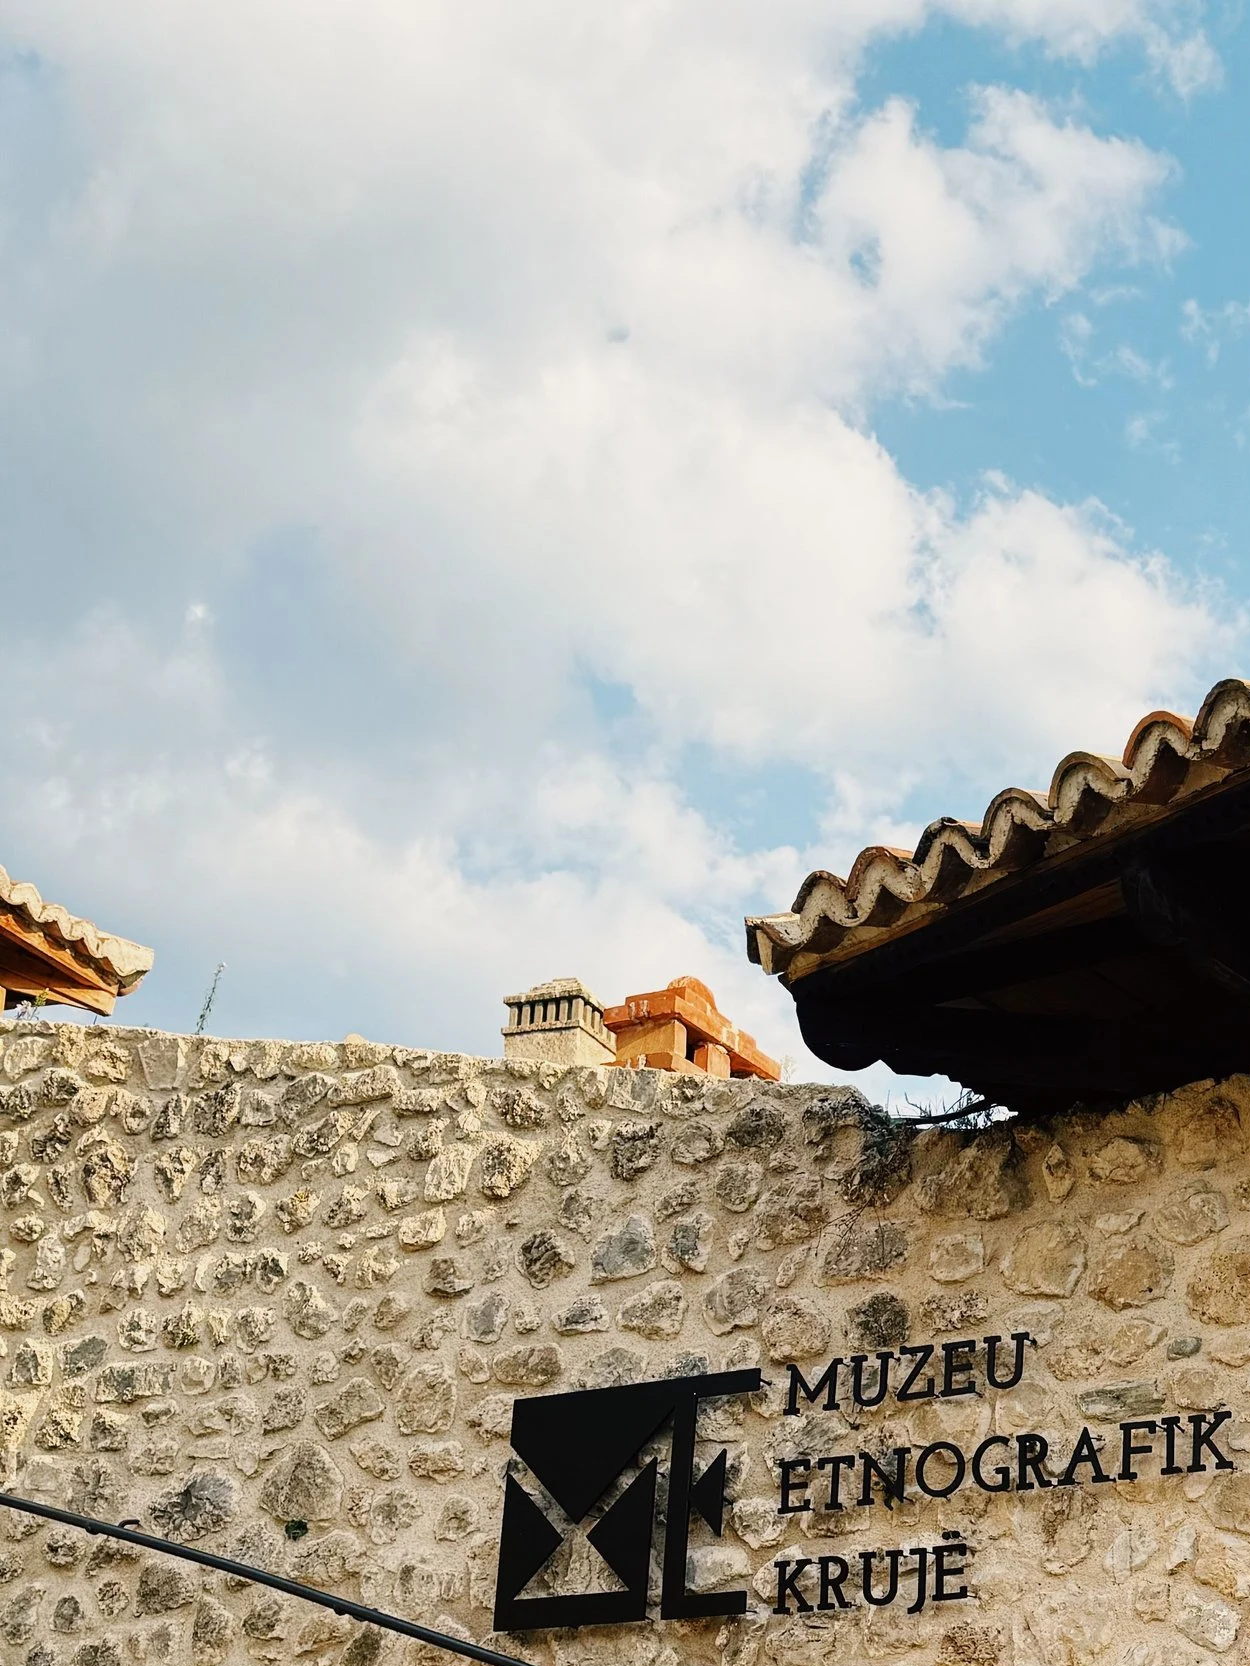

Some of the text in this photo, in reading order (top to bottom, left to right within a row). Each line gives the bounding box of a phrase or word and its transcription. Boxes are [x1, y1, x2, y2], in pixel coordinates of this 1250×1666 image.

[785, 1332, 1032, 1416] MUZEU
[778, 1411, 1234, 1515] ETNOGRAFIK
[773, 1531, 969, 1615] KRUJË
